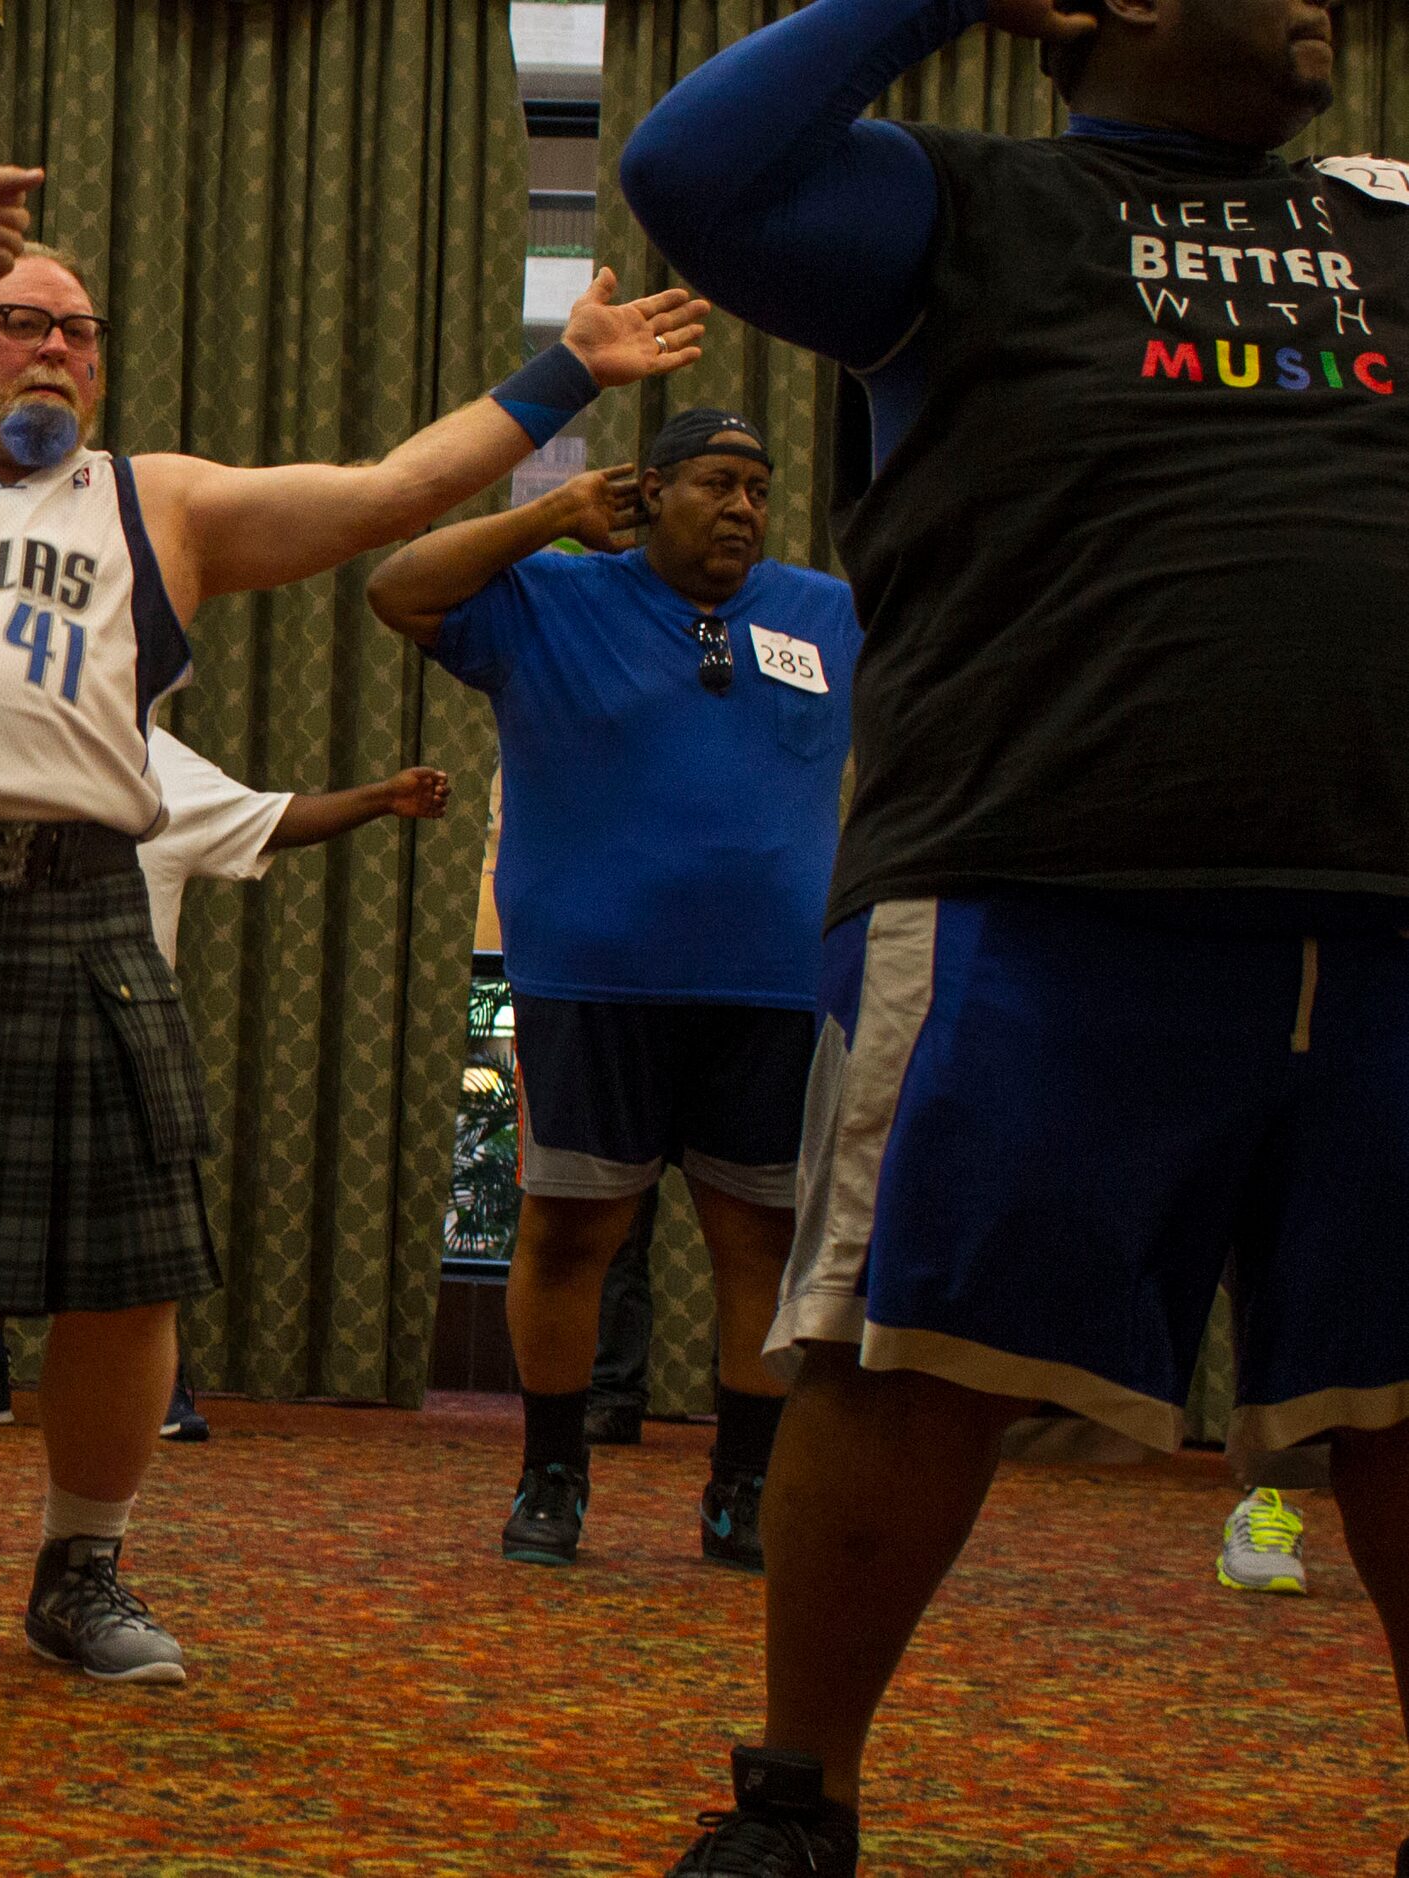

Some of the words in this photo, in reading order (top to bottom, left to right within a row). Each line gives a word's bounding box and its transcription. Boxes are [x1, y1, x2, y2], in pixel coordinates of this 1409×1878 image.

[1120, 200, 1257, 232] LIFE
[1285, 196, 1334, 236] IS
[1130, 234, 1361, 291] BETTER
[1135, 281, 1373, 336] WITH
[1141, 339, 1395, 394] MUSIC
[4, 600, 87, 705] 41
[760, 644, 814, 679] 285
